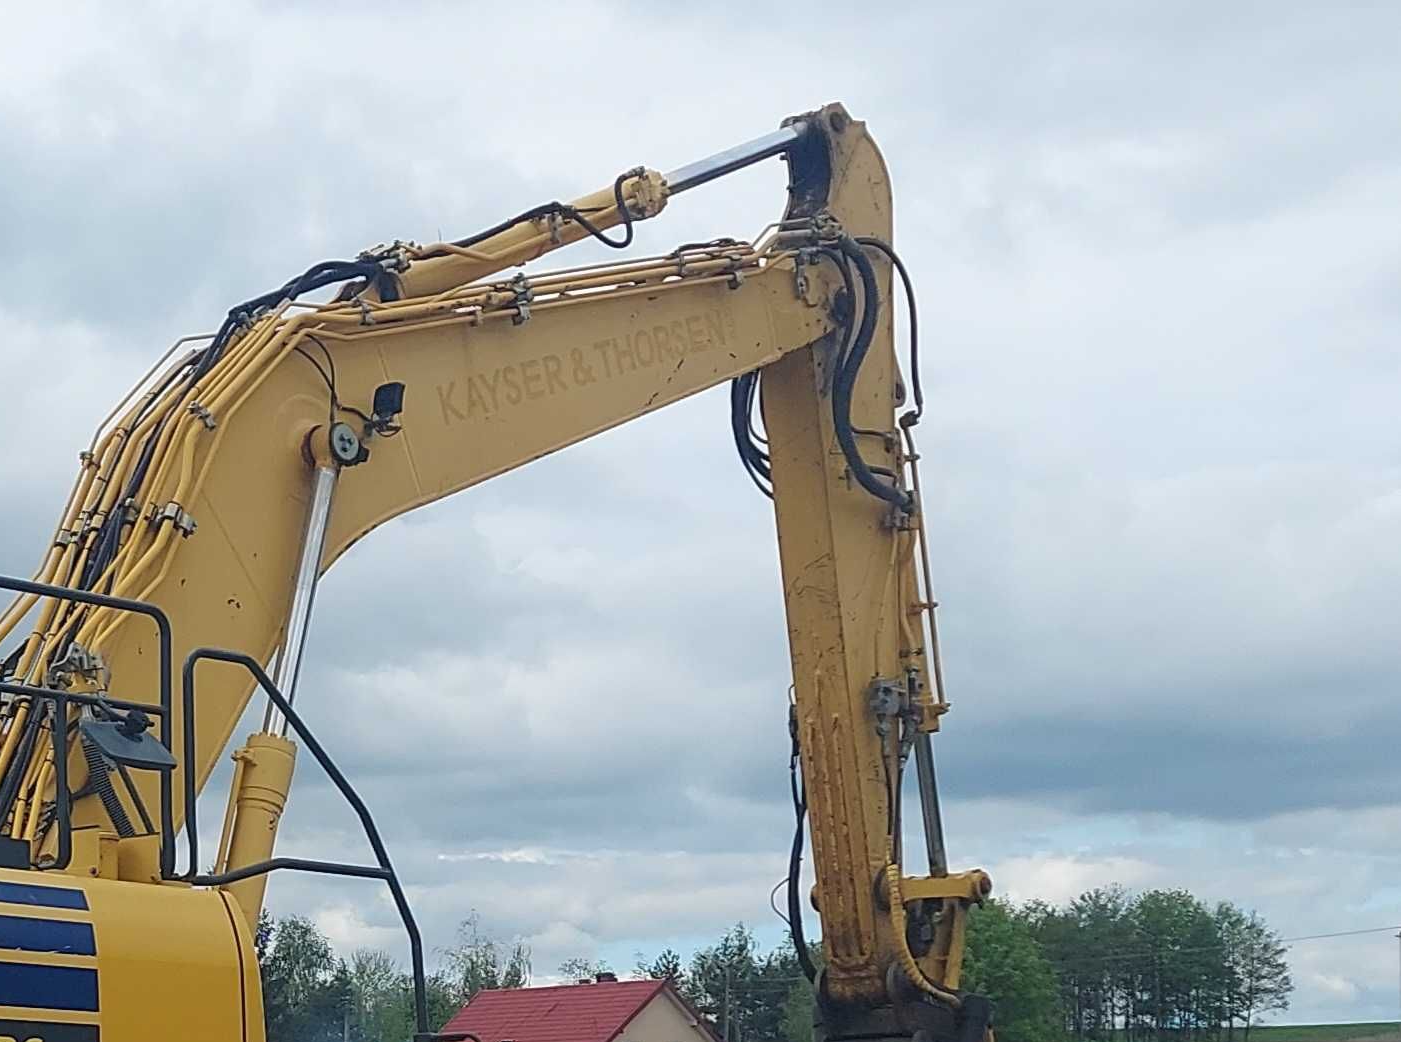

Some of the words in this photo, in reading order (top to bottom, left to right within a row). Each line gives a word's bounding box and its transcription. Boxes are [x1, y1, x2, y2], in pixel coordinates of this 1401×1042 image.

[436, 353, 569, 426] KAYSER
[570, 347, 597, 386] &
[594, 306, 727, 378] THORSEN
